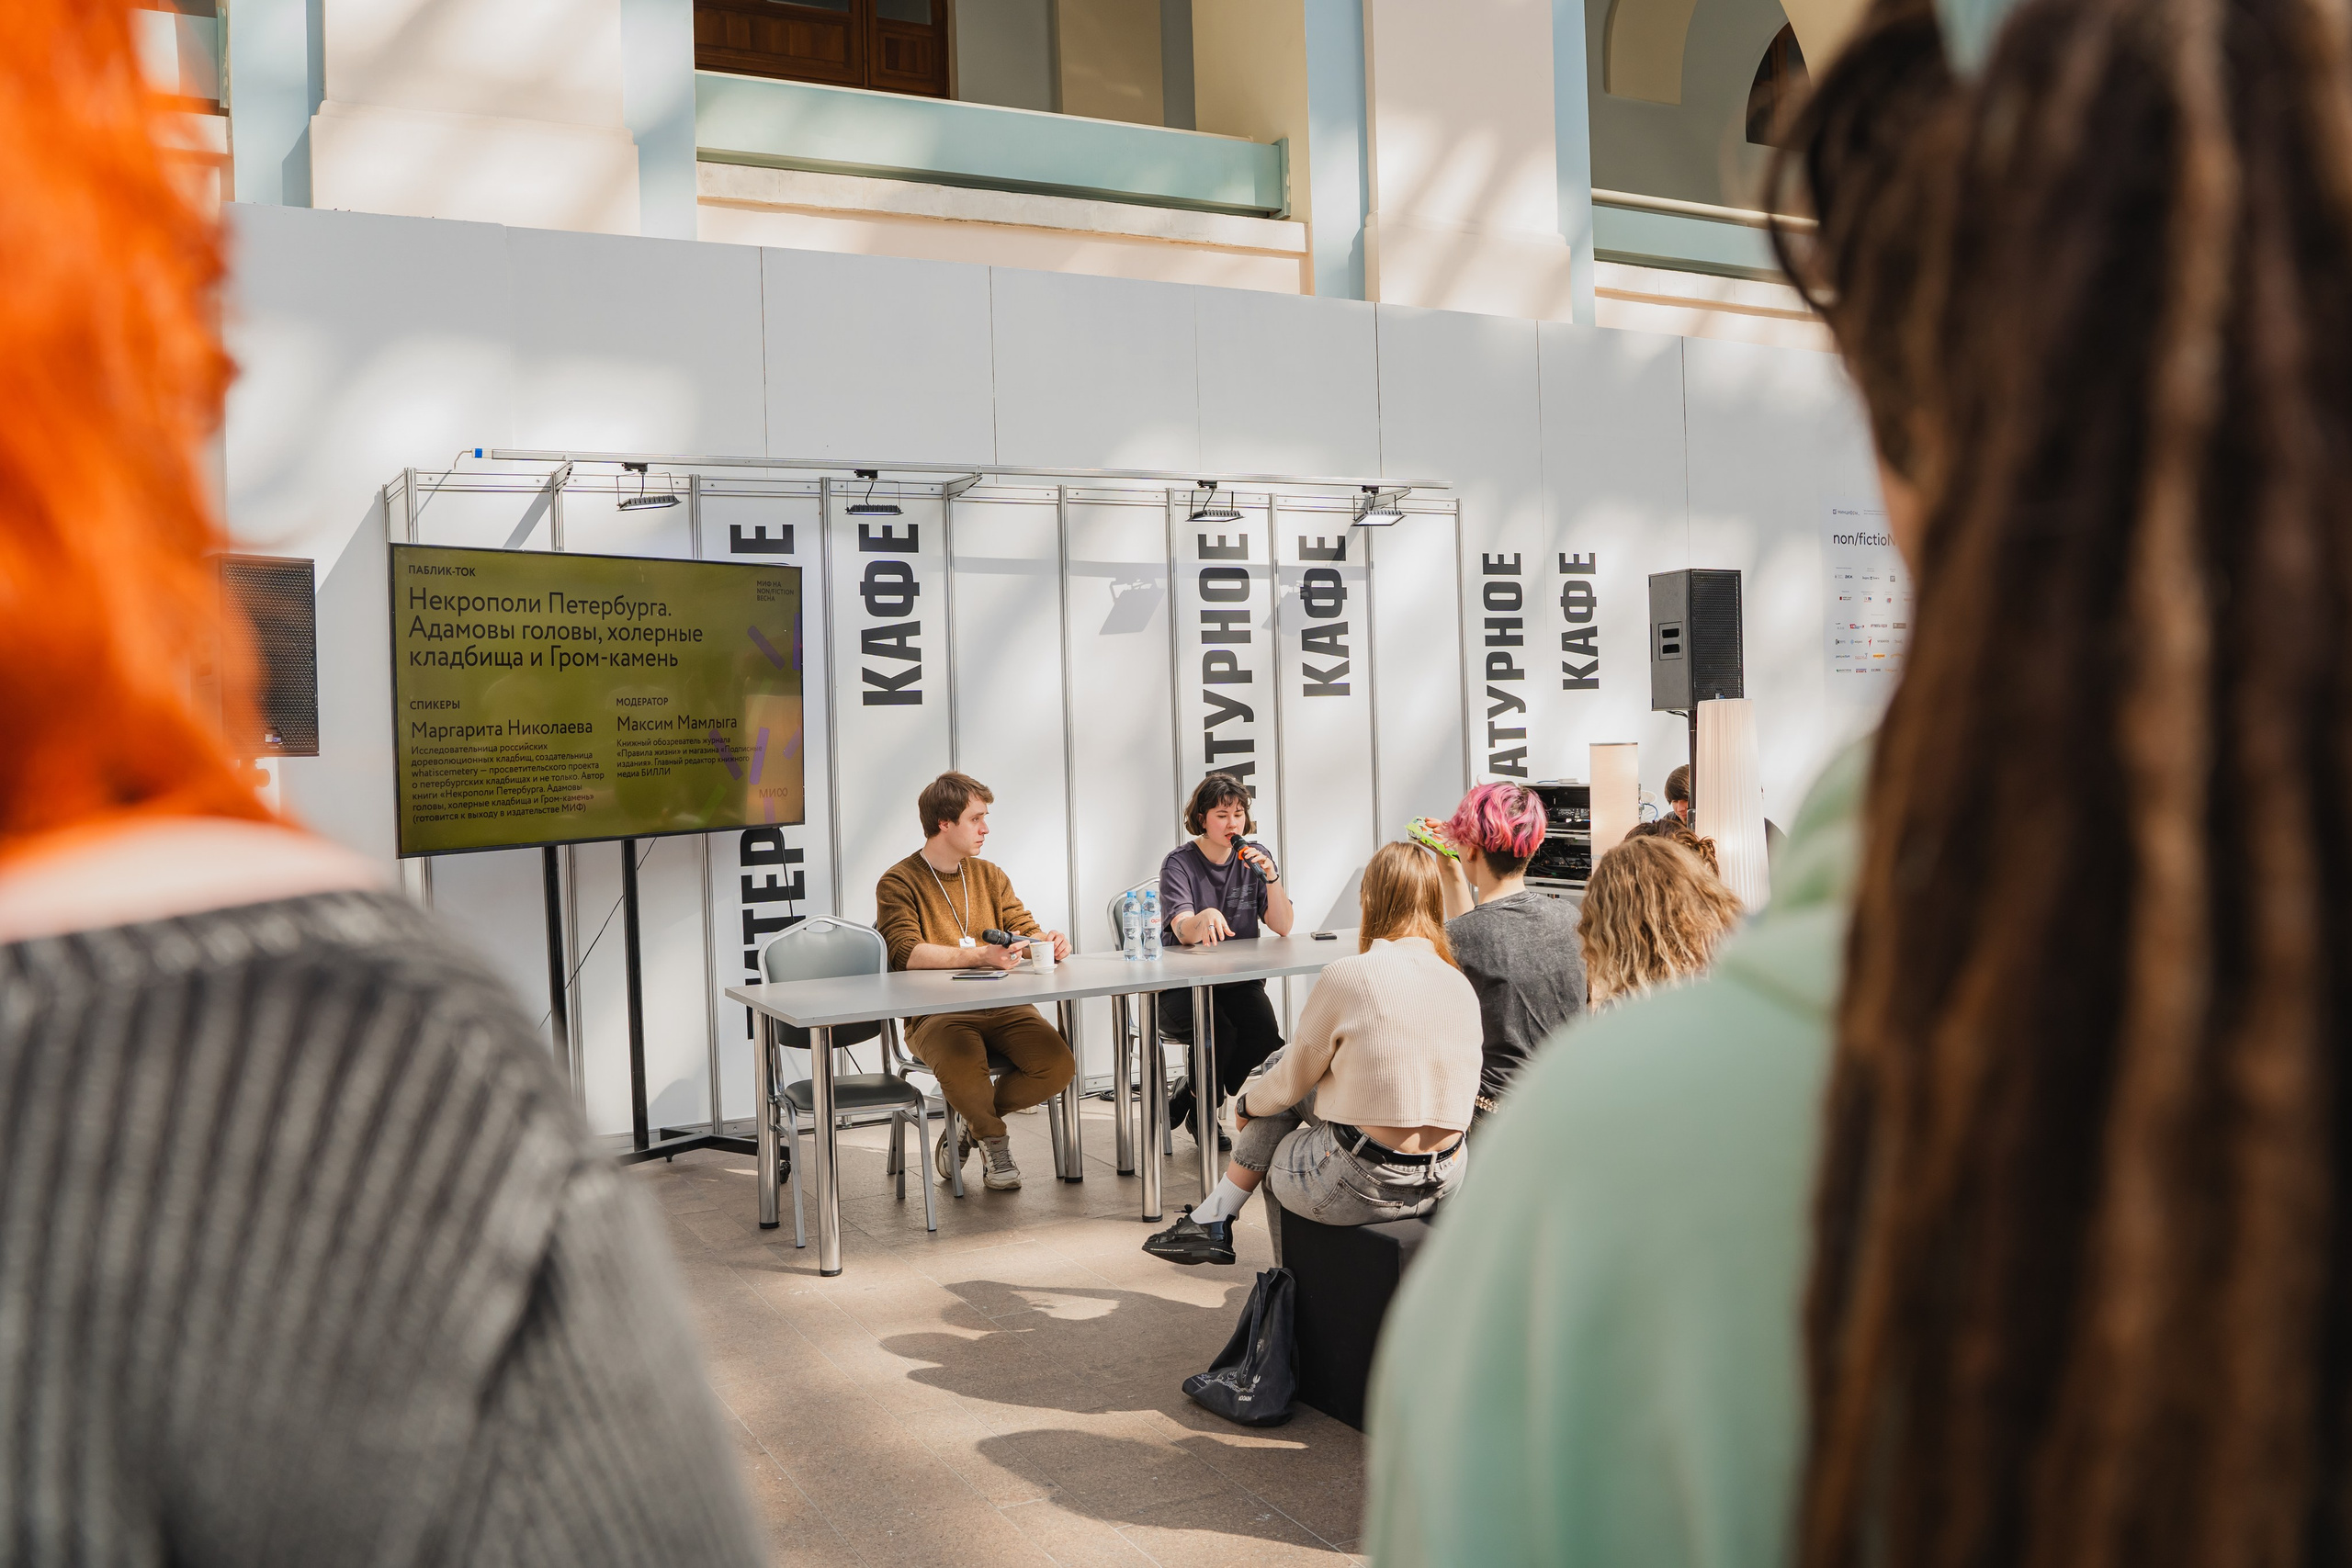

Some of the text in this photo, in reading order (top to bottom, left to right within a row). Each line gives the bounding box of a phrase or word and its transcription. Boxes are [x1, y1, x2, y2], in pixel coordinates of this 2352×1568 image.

[409, 565, 476, 577] ПАБЛИК-ТОК
[410, 587, 672, 621] Некрополи Петербурга.
[858, 524, 922, 705] КАФЕ
[1298, 536, 1351, 697] КАФЕ
[1559, 552, 1600, 690] КАФЕ
[409, 615, 703, 647] Адамовы головы, холерные
[410, 645, 678, 671] кладбища и Гром-камень
[1482, 552, 1528, 778] АТУРНОЕ
[410, 700, 460, 710] СПИКЕРЫ
[616, 697, 668, 706] МОДЕРАТОР
[412, 719, 593, 741] Маргарита Николаева
[617, 715, 737, 731] Максим Мамлыга
[411, 742, 548, 755] Исследовательница российских
[616, 736, 730, 748] Книжный обозреватель журнала
[411, 752, 593, 767] дореволюционных кладбищ, создательница
[616, 748, 652, 759] «Правила
[720, 745, 763, 754] «Подписные
[412, 767, 478, 777] whatiscemetery
[489, 764, 566, 775] просветительского
[568, 762, 599, 772] проекта
[616, 755, 750, 769] издания». Главный редактор книжного
[420, 778, 483, 789] петербургских
[486, 775, 530, 786] кладбищах
[551, 773, 579, 782] только.
[581, 771, 605, 781] Автор
[616, 768, 671, 778] медиа БИЛЛИ
[413, 783, 582, 800] книги «Некрополи Петербурга. Адамовы
[413, 802, 447, 812] головы,
[447, 799, 490, 810] холерные
[492, 796, 532, 807] кладбища
[541, 793, 594, 805] Гром-камень»
[413, 812, 458, 825] (готовится
[468, 811, 498, 821] выходу
[507, 806, 560, 817] издательстве
[561, 803, 586, 814] МИФ)
